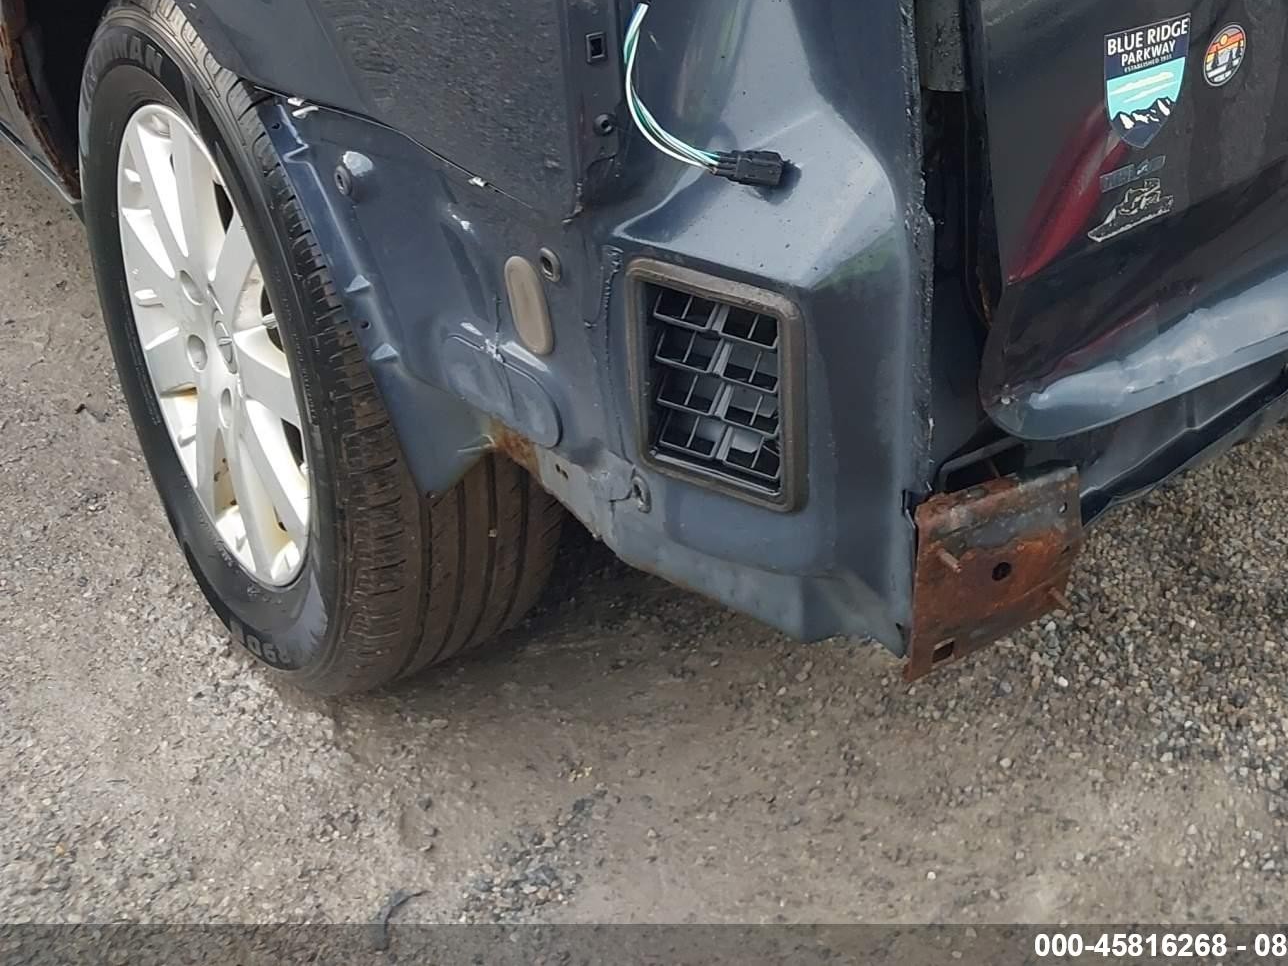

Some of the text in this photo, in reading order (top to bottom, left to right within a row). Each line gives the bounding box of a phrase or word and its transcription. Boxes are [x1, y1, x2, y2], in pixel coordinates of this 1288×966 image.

[1107, 17, 1188, 56] BLUE RIDGE
[1121, 39, 1176, 66] PARKWAY
